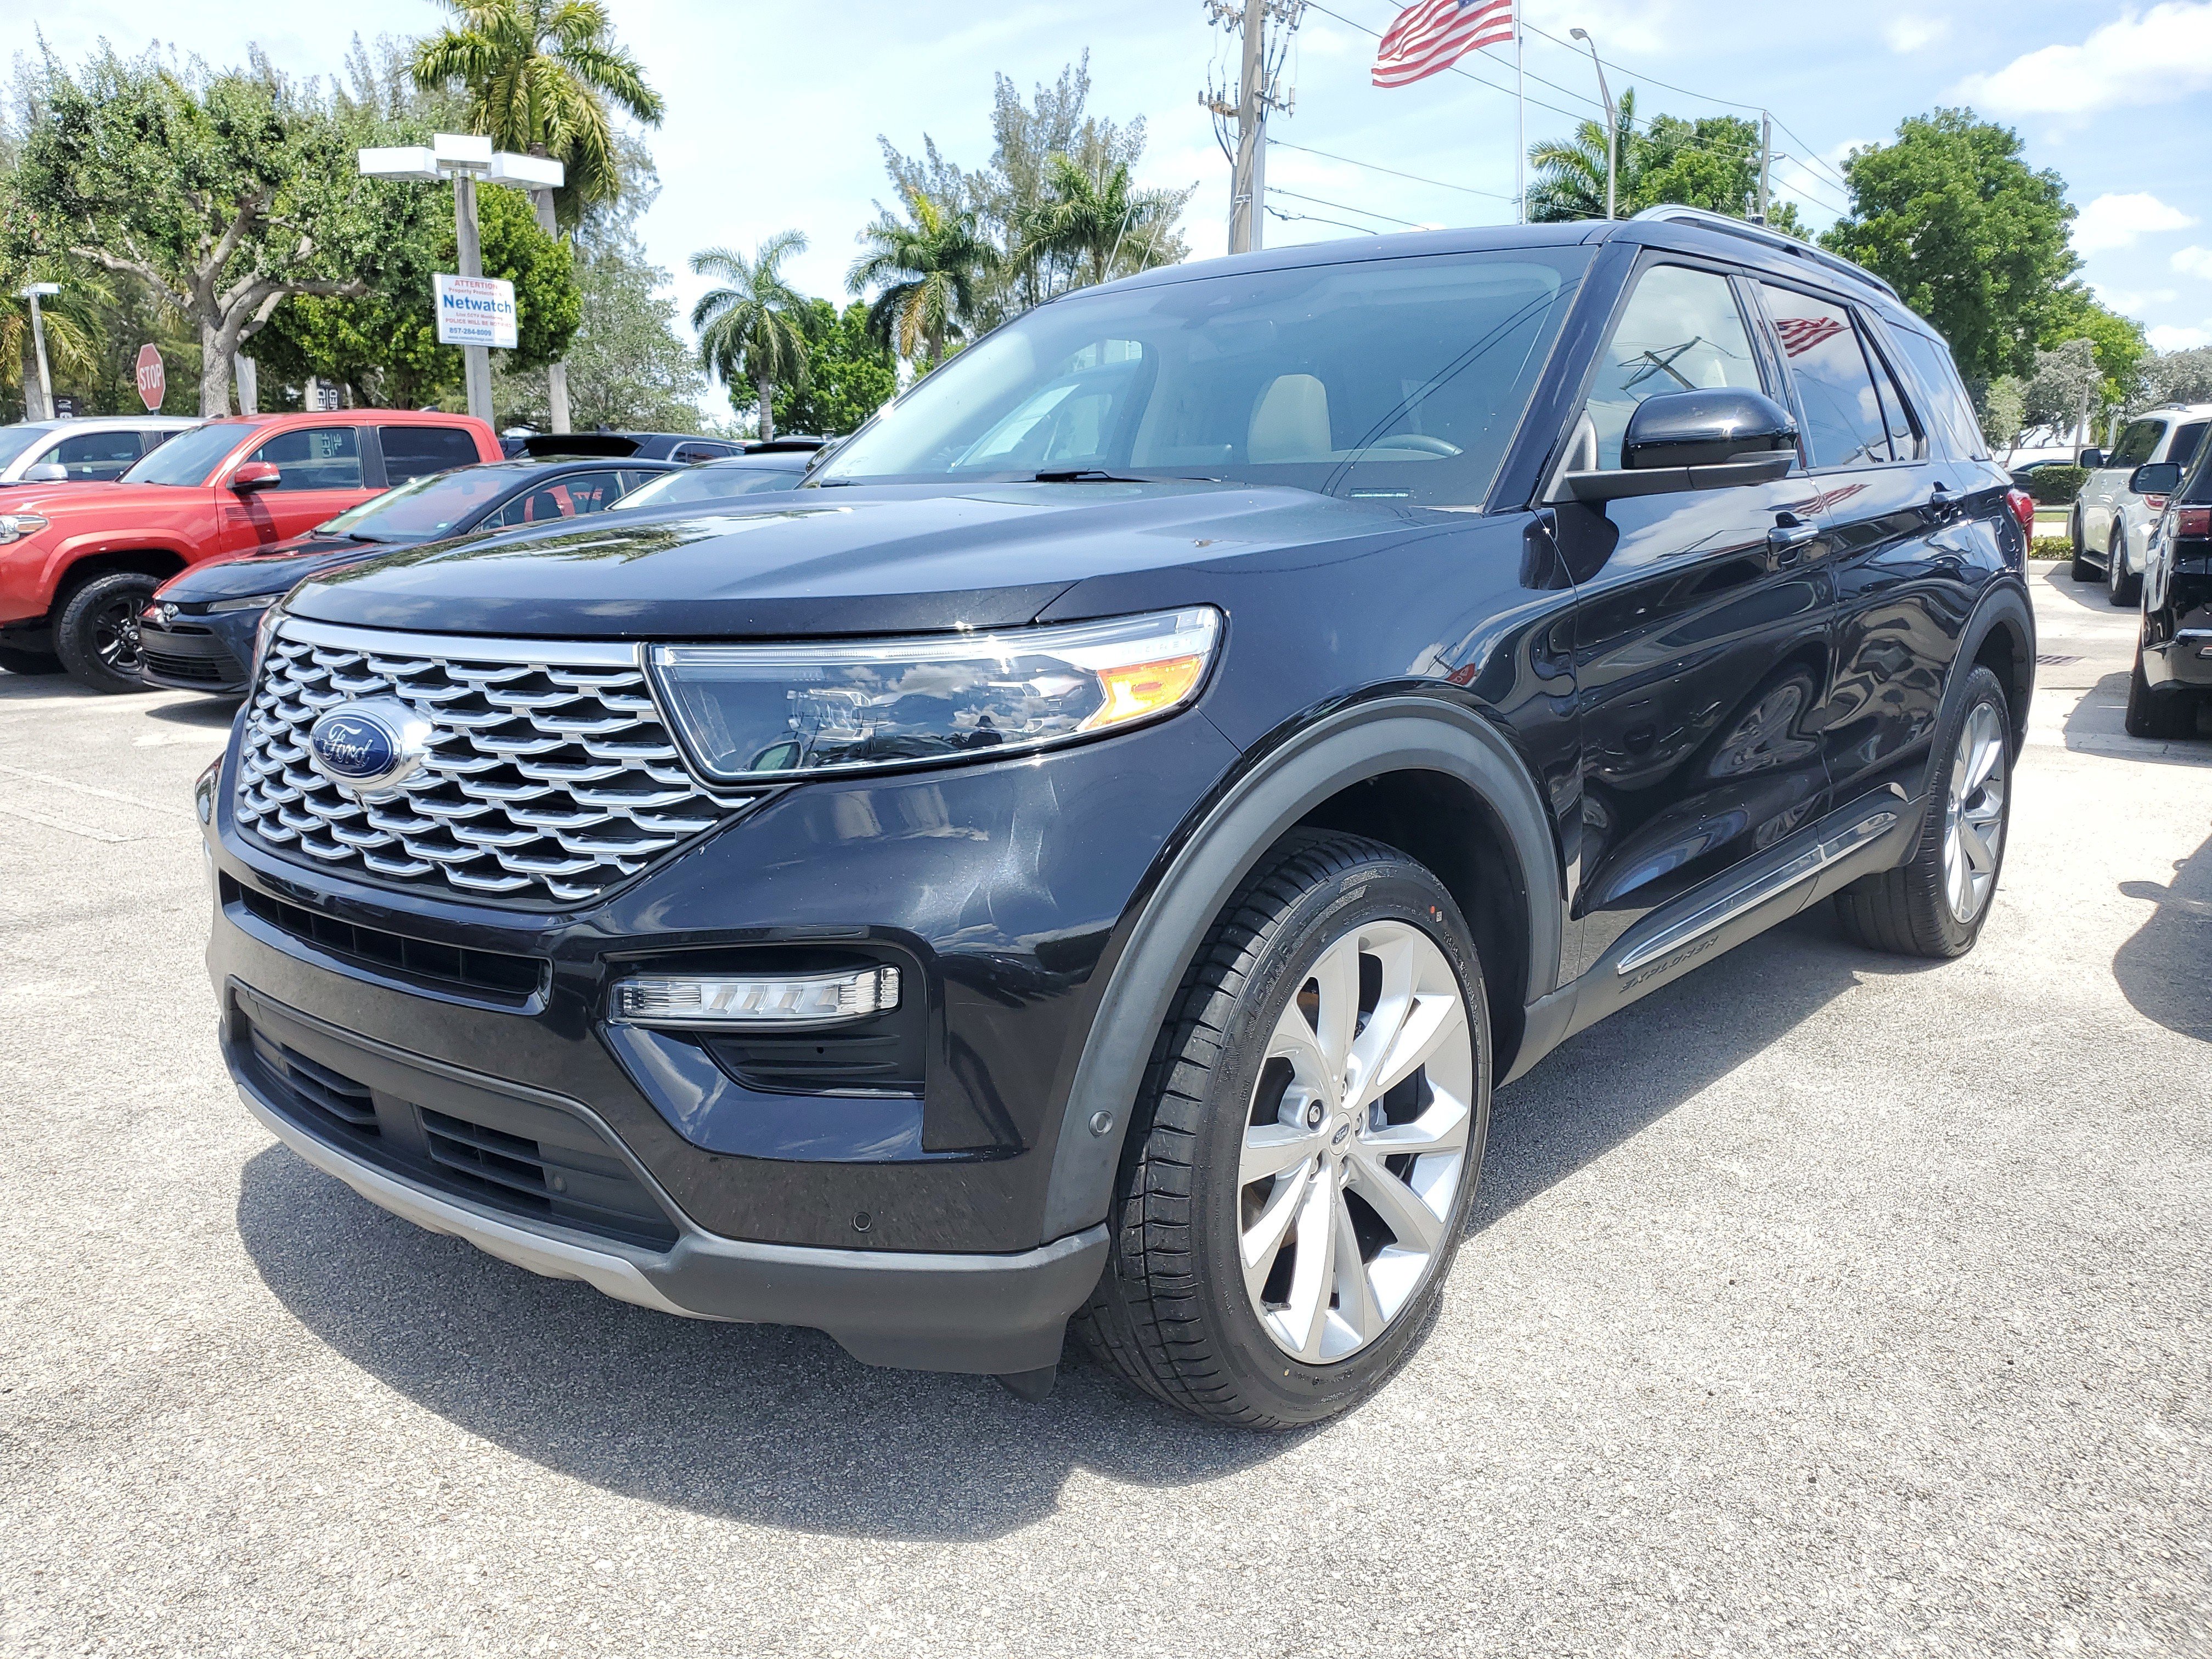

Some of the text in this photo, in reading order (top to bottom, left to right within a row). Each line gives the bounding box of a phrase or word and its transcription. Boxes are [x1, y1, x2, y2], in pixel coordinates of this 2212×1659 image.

[443, 294, 512, 314] Netwatch
[139, 363, 162, 391] STOP
[323, 723, 373, 768] Ford
[1335, 1126, 1348, 1143] Ford
